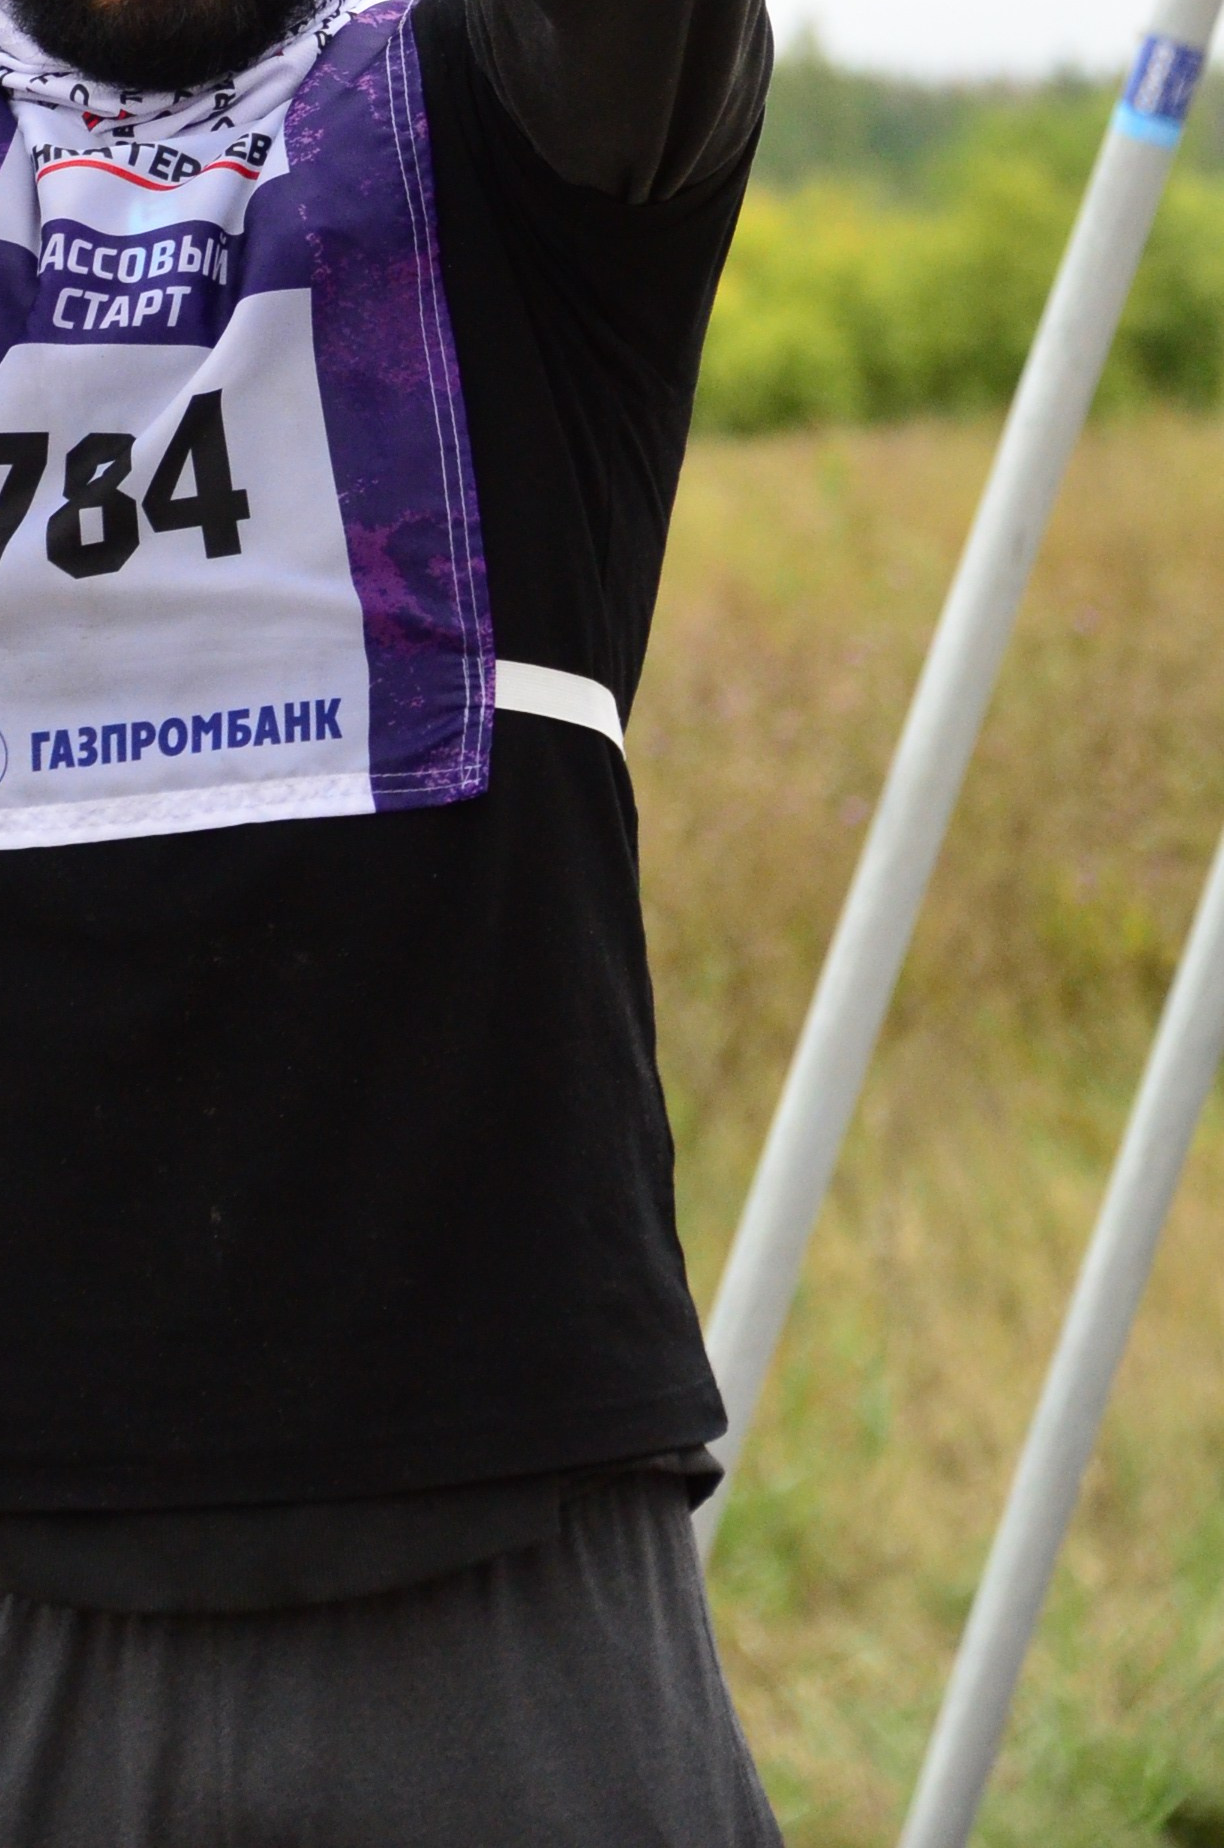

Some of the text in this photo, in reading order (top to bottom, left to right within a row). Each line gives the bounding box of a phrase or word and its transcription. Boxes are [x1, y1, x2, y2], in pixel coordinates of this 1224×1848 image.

[37, 230, 228, 286] АССОВЫЙ
[52, 286, 192, 330] СТАРТ
[30, 697, 343, 772] ГАЗПРОМБАНК
